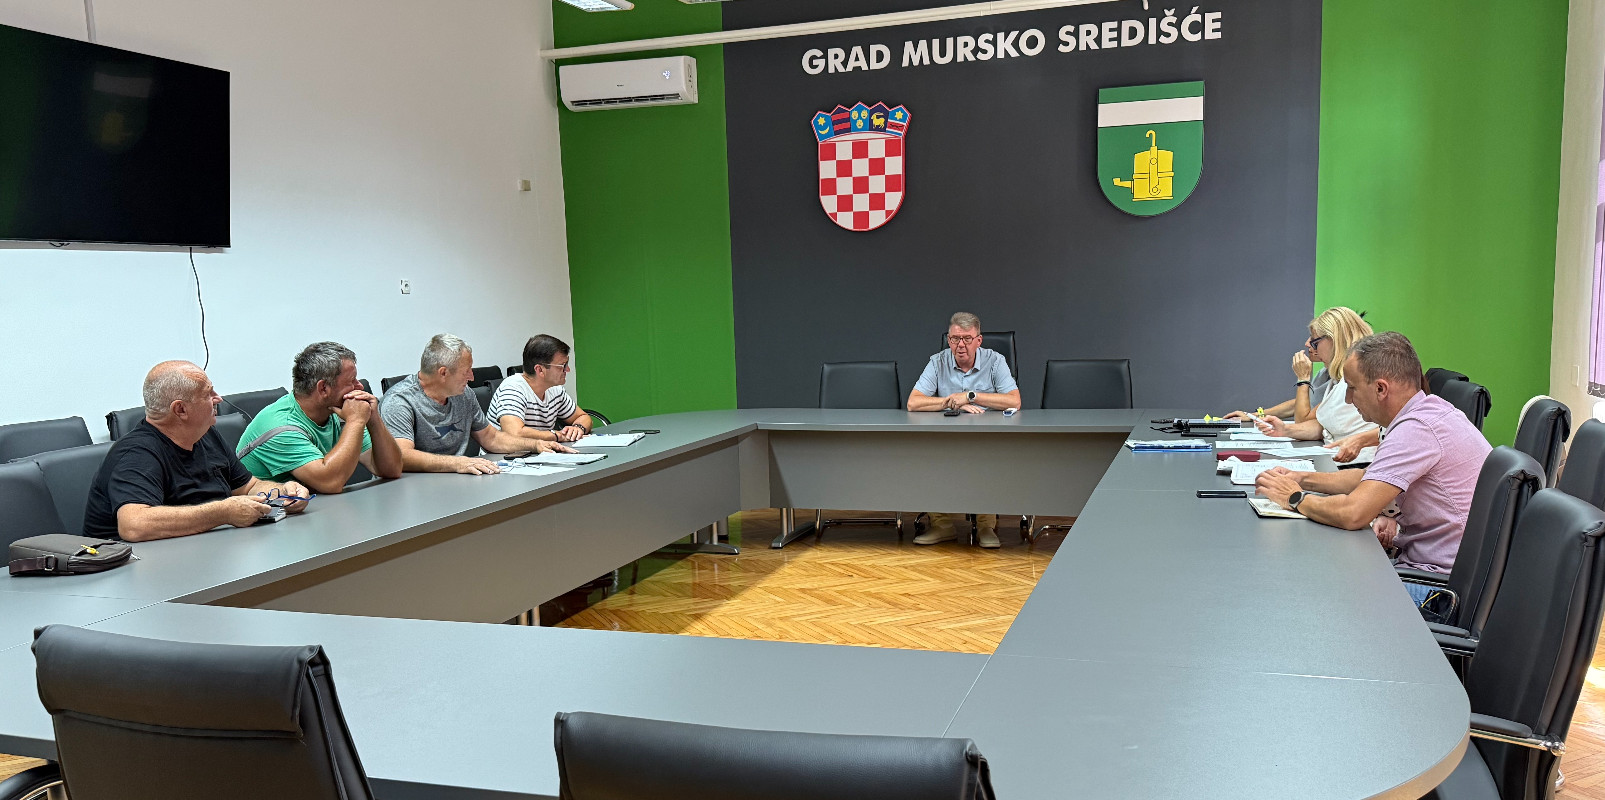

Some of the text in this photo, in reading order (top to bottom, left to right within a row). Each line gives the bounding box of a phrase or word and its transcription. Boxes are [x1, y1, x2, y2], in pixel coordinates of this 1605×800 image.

[801, 6, 1222, 75] GRAD MURSKO SREDIŠĆE
